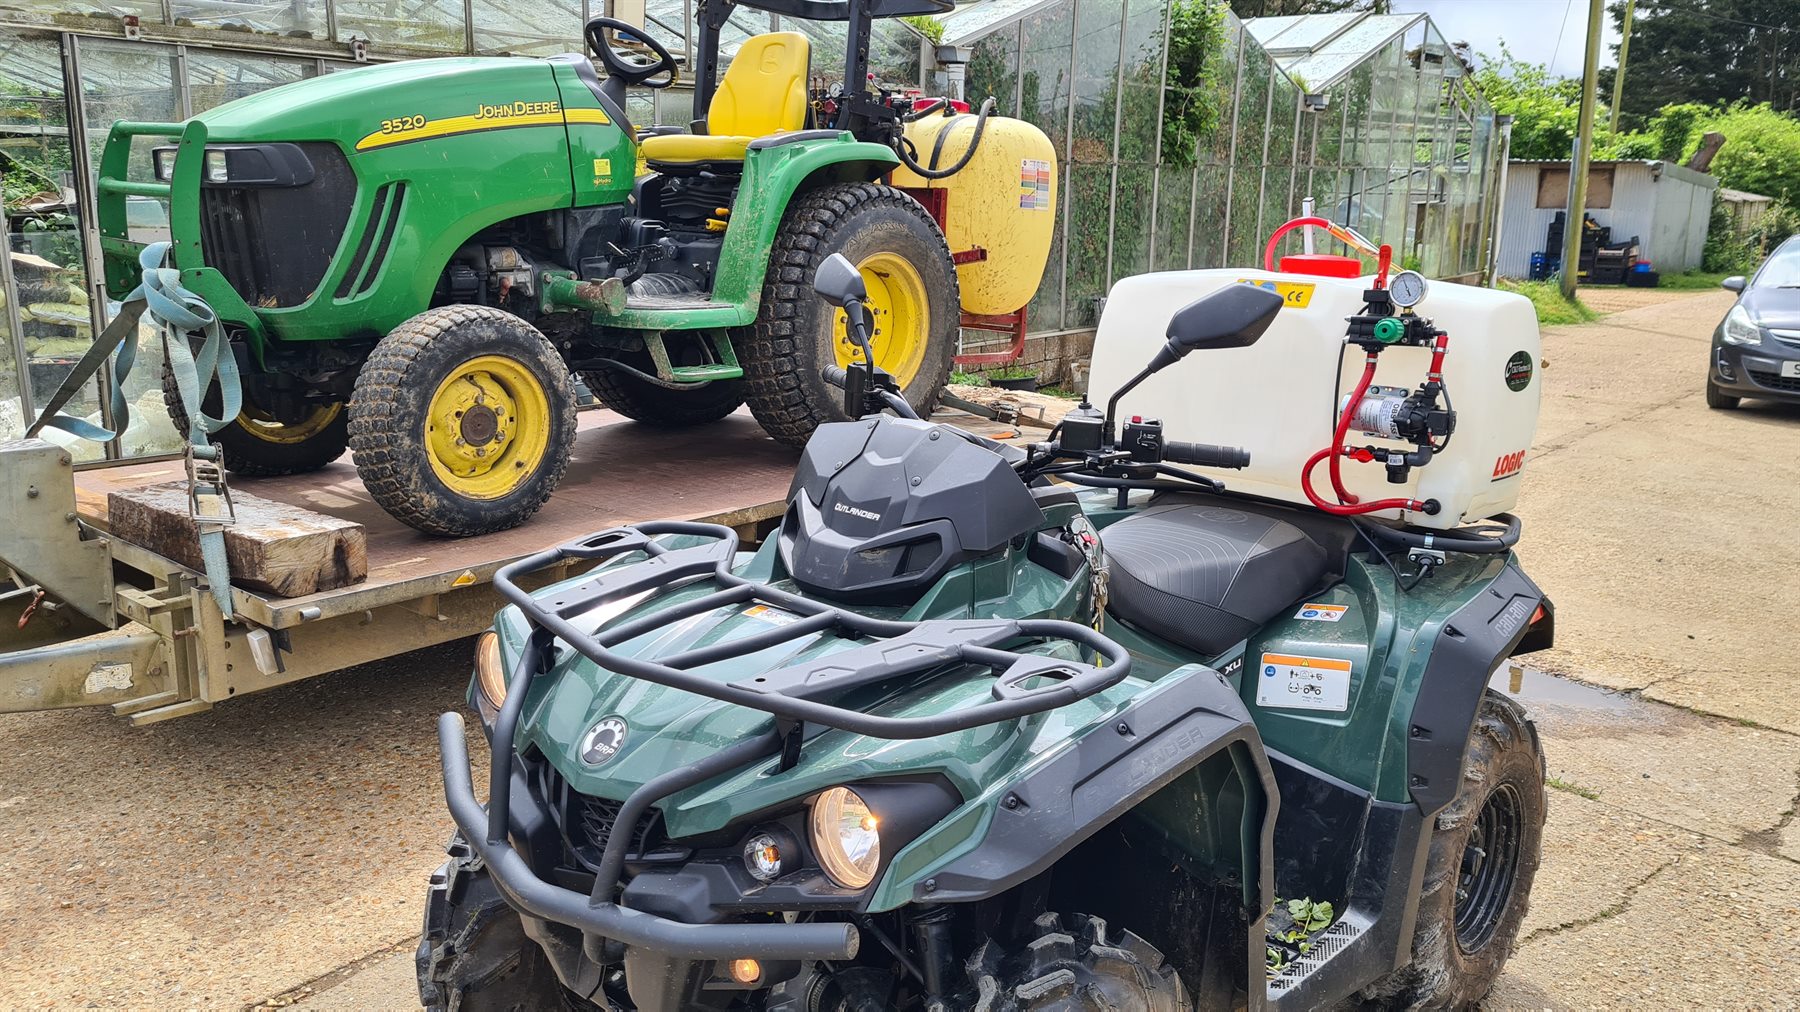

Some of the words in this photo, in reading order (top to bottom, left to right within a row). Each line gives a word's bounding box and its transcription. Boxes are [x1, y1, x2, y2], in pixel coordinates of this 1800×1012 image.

[474, 102, 514, 120] JOHN
[514, 100, 560, 116] DEERE
[381, 114, 425, 134] 3520
[1492, 449, 1526, 477] LOGIC
[834, 502, 881, 521] OUTLANDER
[594, 742, 615, 755] BRP
